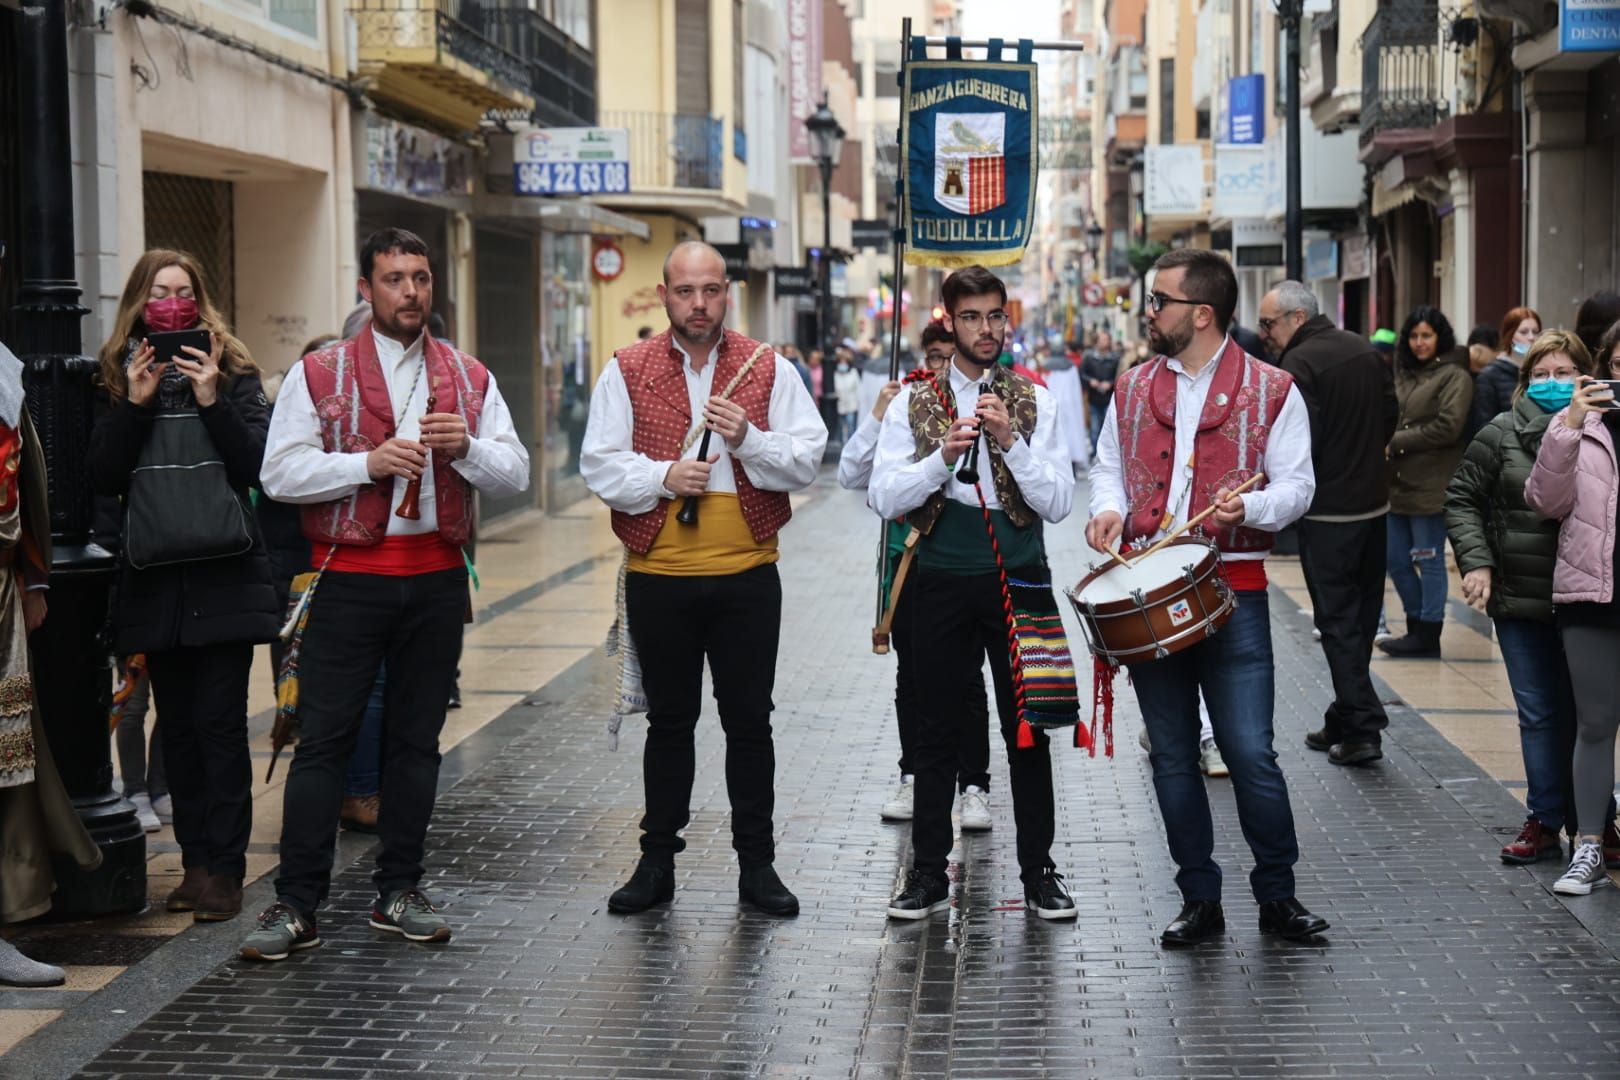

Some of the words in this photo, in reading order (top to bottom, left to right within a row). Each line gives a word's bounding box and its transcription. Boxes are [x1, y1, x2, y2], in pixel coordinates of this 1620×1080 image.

[954, 78, 1028, 111] GUERRERA
[518, 163, 551, 192] 964
[554, 163, 577, 192] 22
[579, 163, 601, 192] 63
[604, 163, 627, 192] 08
